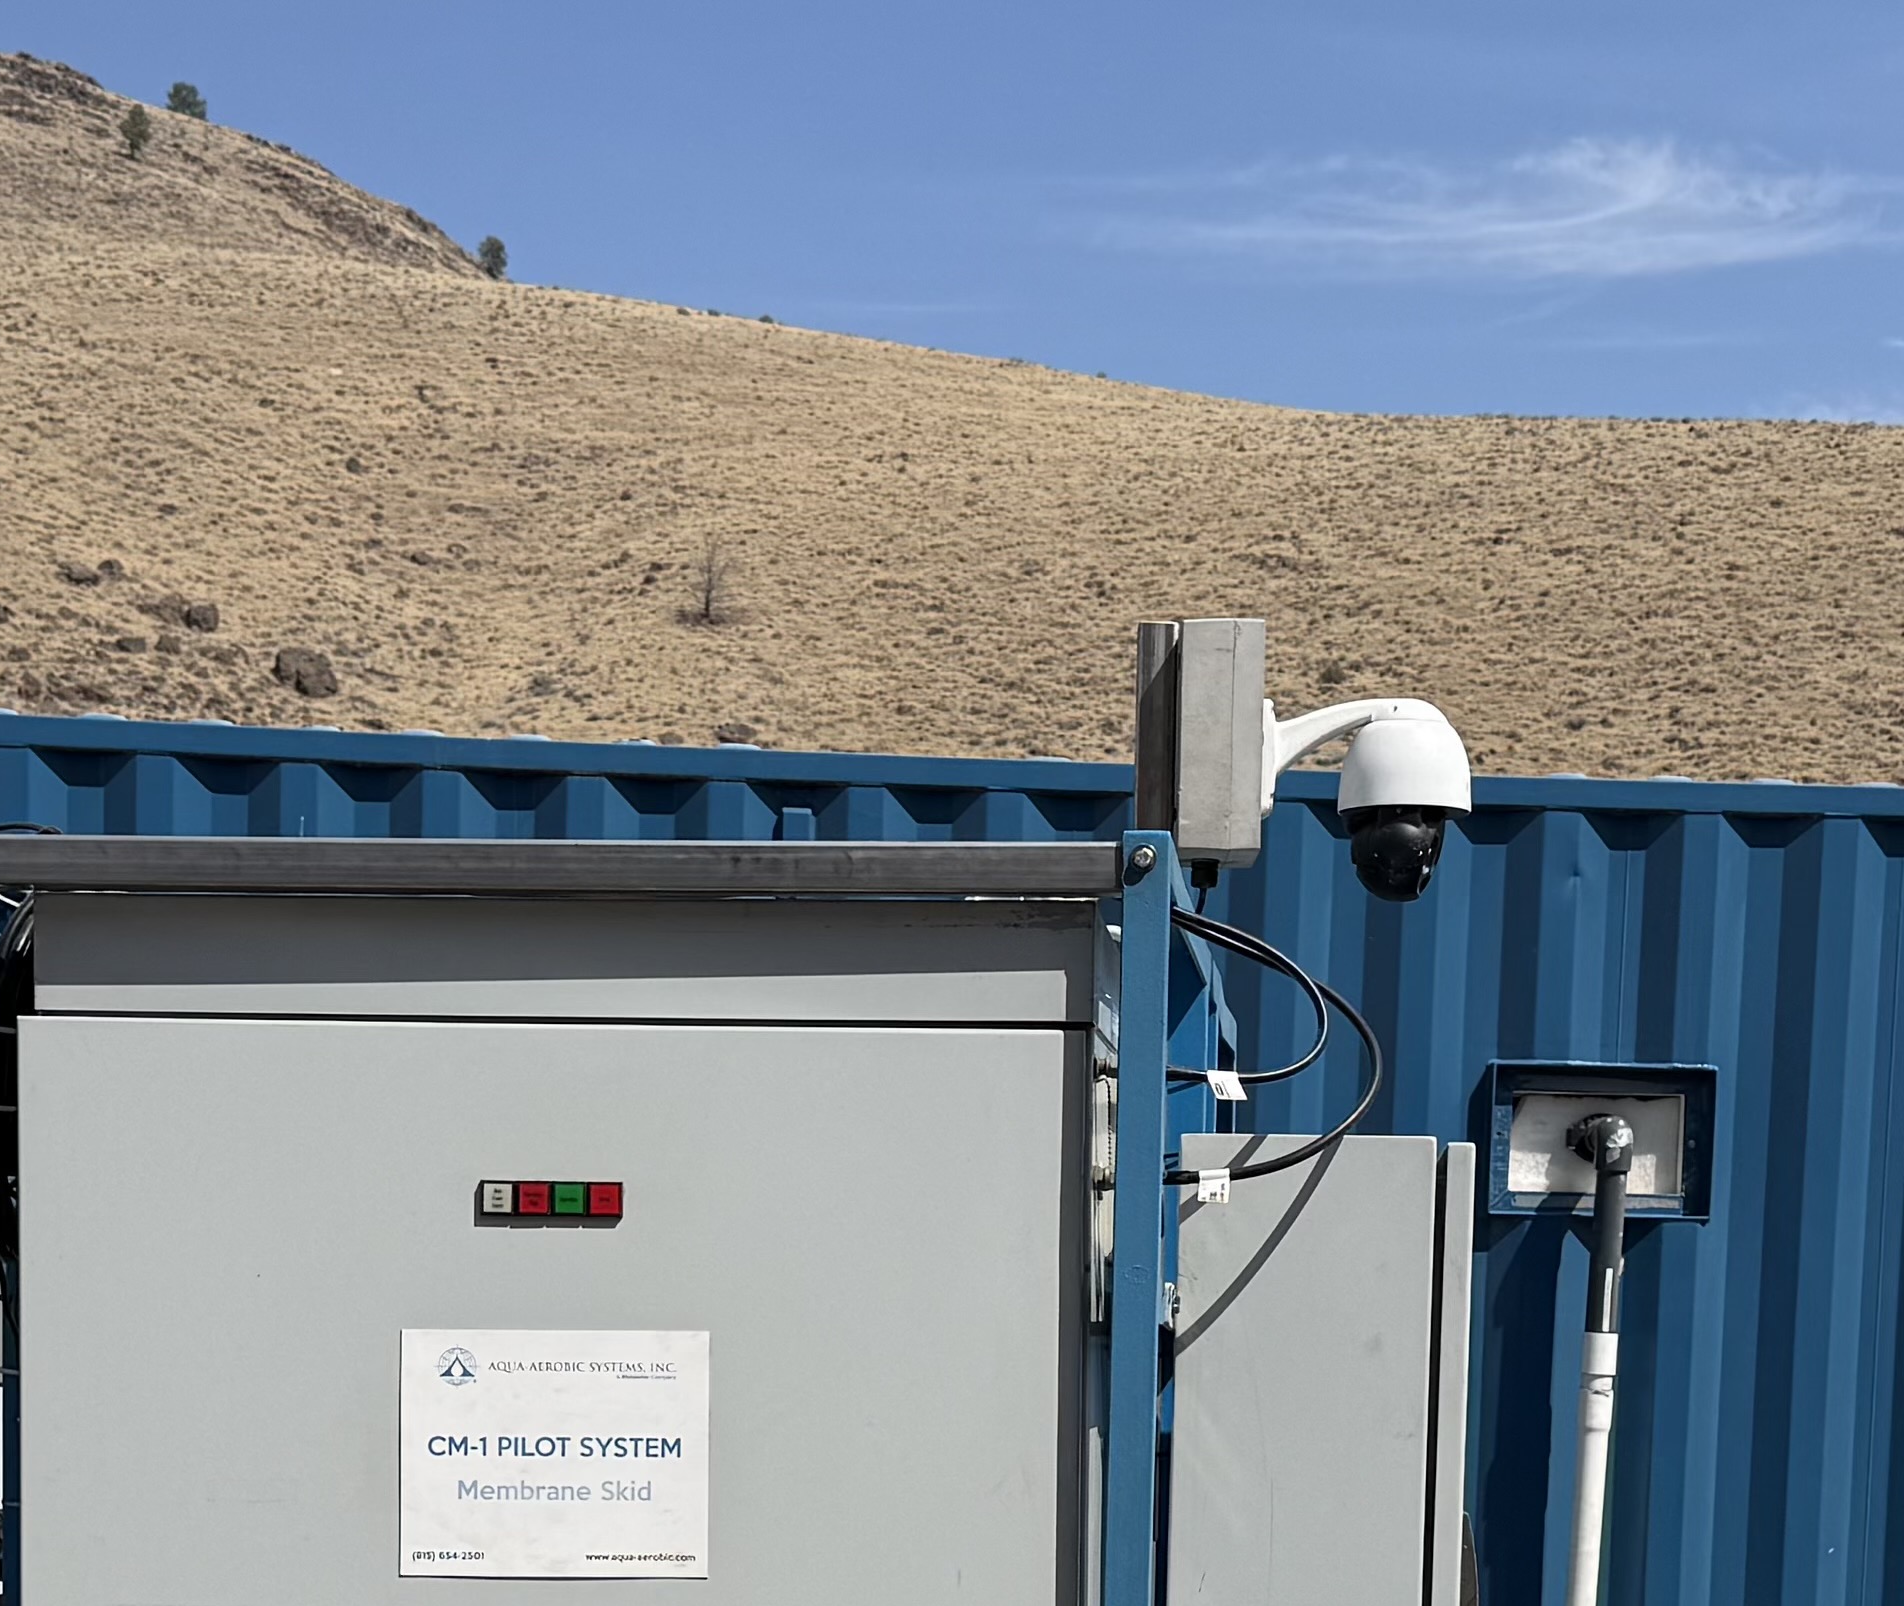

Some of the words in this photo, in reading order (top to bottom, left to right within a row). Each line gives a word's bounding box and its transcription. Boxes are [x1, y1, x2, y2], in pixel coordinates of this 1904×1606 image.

[488, 1361, 585, 1373] AQUA-AEROBIC
[589, 1362, 646, 1373] SYSTEMS,
[428, 1436, 487, 1456] CM-1
[497, 1437, 571, 1457] PILOT
[580, 1437, 682, 1458] SYSTEM
[457, 1480, 591, 1501] Membrane
[601, 1481, 652, 1501] Skid
